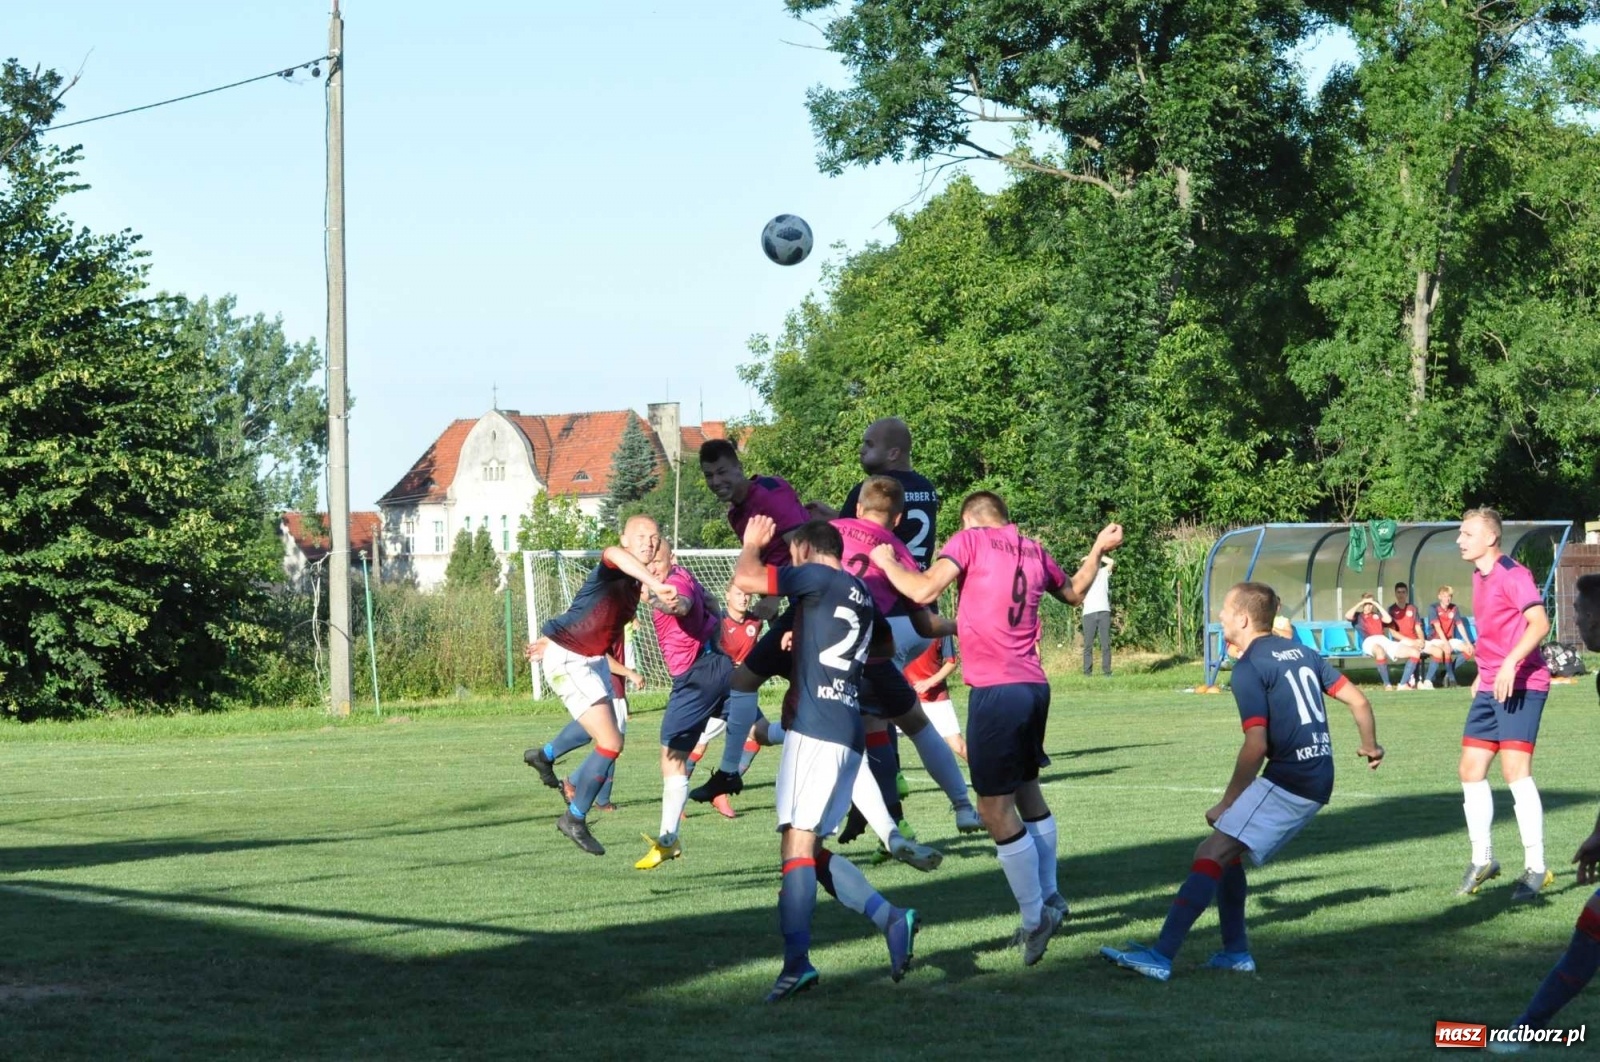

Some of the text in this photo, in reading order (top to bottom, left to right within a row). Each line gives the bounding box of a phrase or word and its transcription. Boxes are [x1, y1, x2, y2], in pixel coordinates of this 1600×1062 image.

[904, 491, 930, 502] ERBER
[906, 508, 930, 556] 2
[1007, 566, 1028, 628] 9
[1284, 666, 1326, 725] 10
